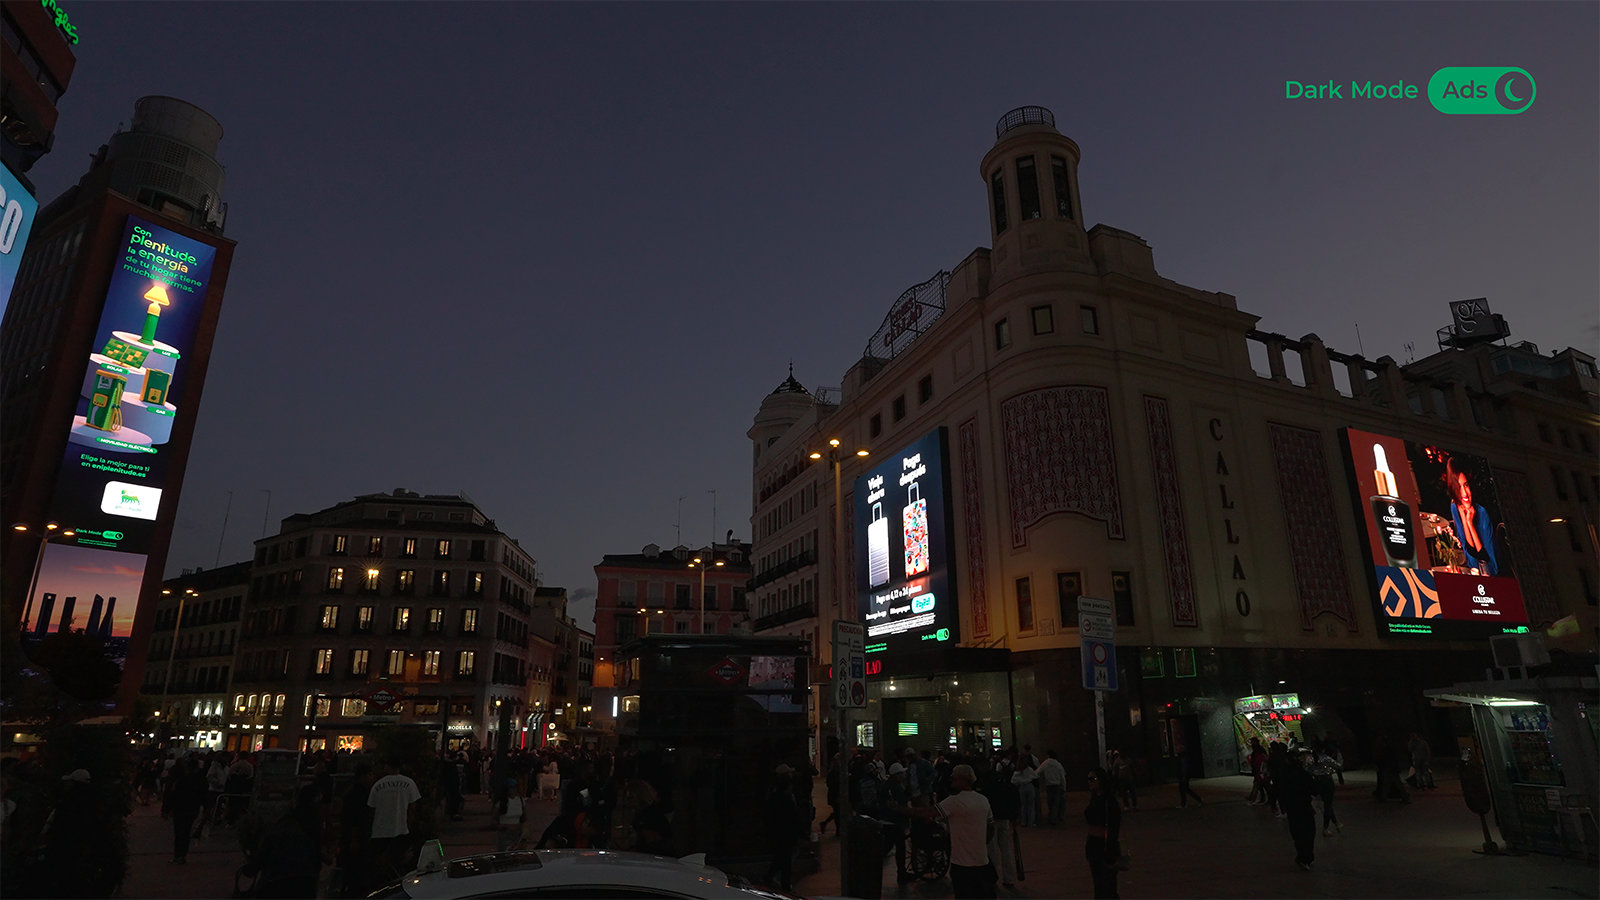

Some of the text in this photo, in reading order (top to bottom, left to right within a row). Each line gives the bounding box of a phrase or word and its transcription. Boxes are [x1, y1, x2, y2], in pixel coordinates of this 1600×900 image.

[134, 226, 152, 238] Con
[127, 246, 189, 273] la energía
[130, 234, 198, 266] plenitude.
[123, 264, 194, 293] muchas formas.
[125, 255, 202, 287] de tu hogar tiene
[100, 438, 128, 448] MOVILIDAD
[80, 453, 98, 462] Elige
[107, 459, 127, 468] mejor
[128, 463, 144, 471] para
[92, 463, 146, 478] eniplenitude.es
[1209, 418, 1250, 617] CALLAO
